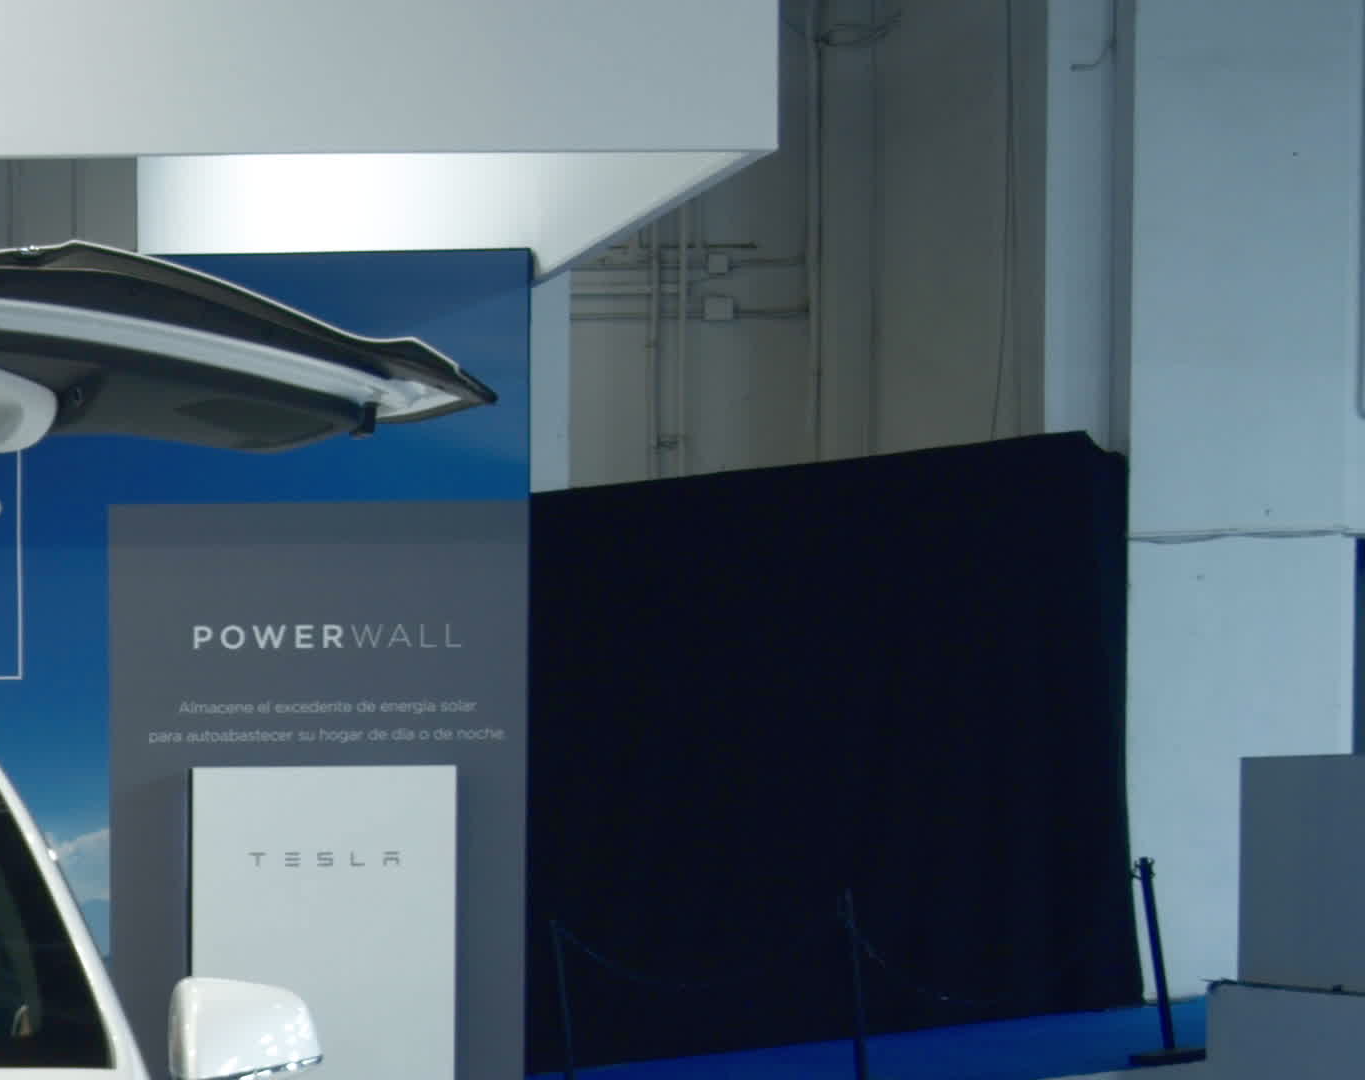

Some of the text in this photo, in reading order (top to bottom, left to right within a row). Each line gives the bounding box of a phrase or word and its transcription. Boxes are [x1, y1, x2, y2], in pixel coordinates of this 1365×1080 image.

[192, 622, 463, 651] POWERWALL
[179, 700, 254, 714] Almacene
[257, 700, 270, 713] el
[274, 701, 352, 714] excedente
[356, 700, 376, 713] de
[148, 731, 183, 745] para
[186, 729, 293, 744] autoabastecer
[297, 731, 316, 743] su
[319, 728, 364, 744] hogar
[367, 728, 389, 742] de
[419, 730, 430, 741] o
[433, 728, 454, 741] de
[248, 850, 402, 868] TESLA
